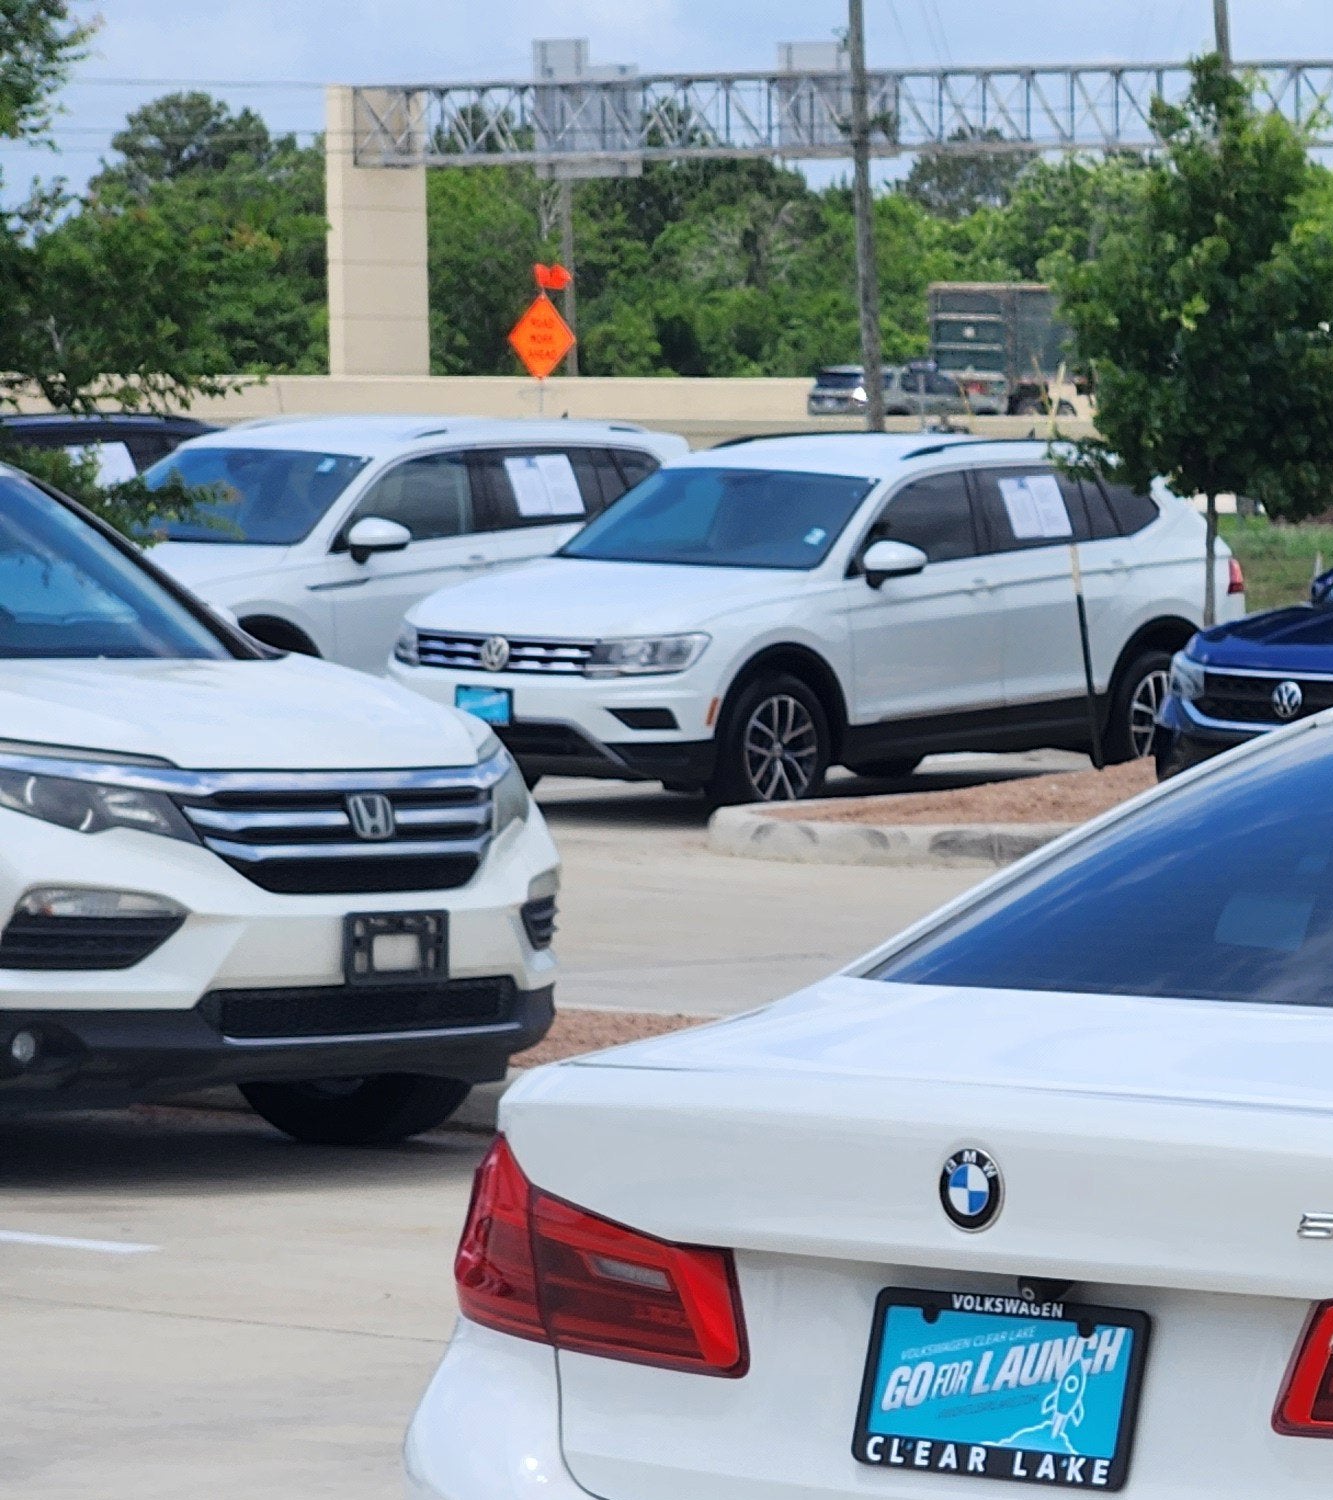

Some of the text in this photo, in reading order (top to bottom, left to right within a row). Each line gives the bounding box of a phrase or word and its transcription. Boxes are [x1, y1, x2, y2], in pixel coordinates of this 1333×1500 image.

[945, 1150, 998, 1179] BMW
[951, 1293, 1064, 1319] VOLKSWAGEN
[880, 1361, 935, 1412] GO
[930, 1360, 974, 1400] FOR
[970, 1326, 1128, 1396] LAUNCH
[865, 1435, 1112, 1485] CLEAR LAKE
